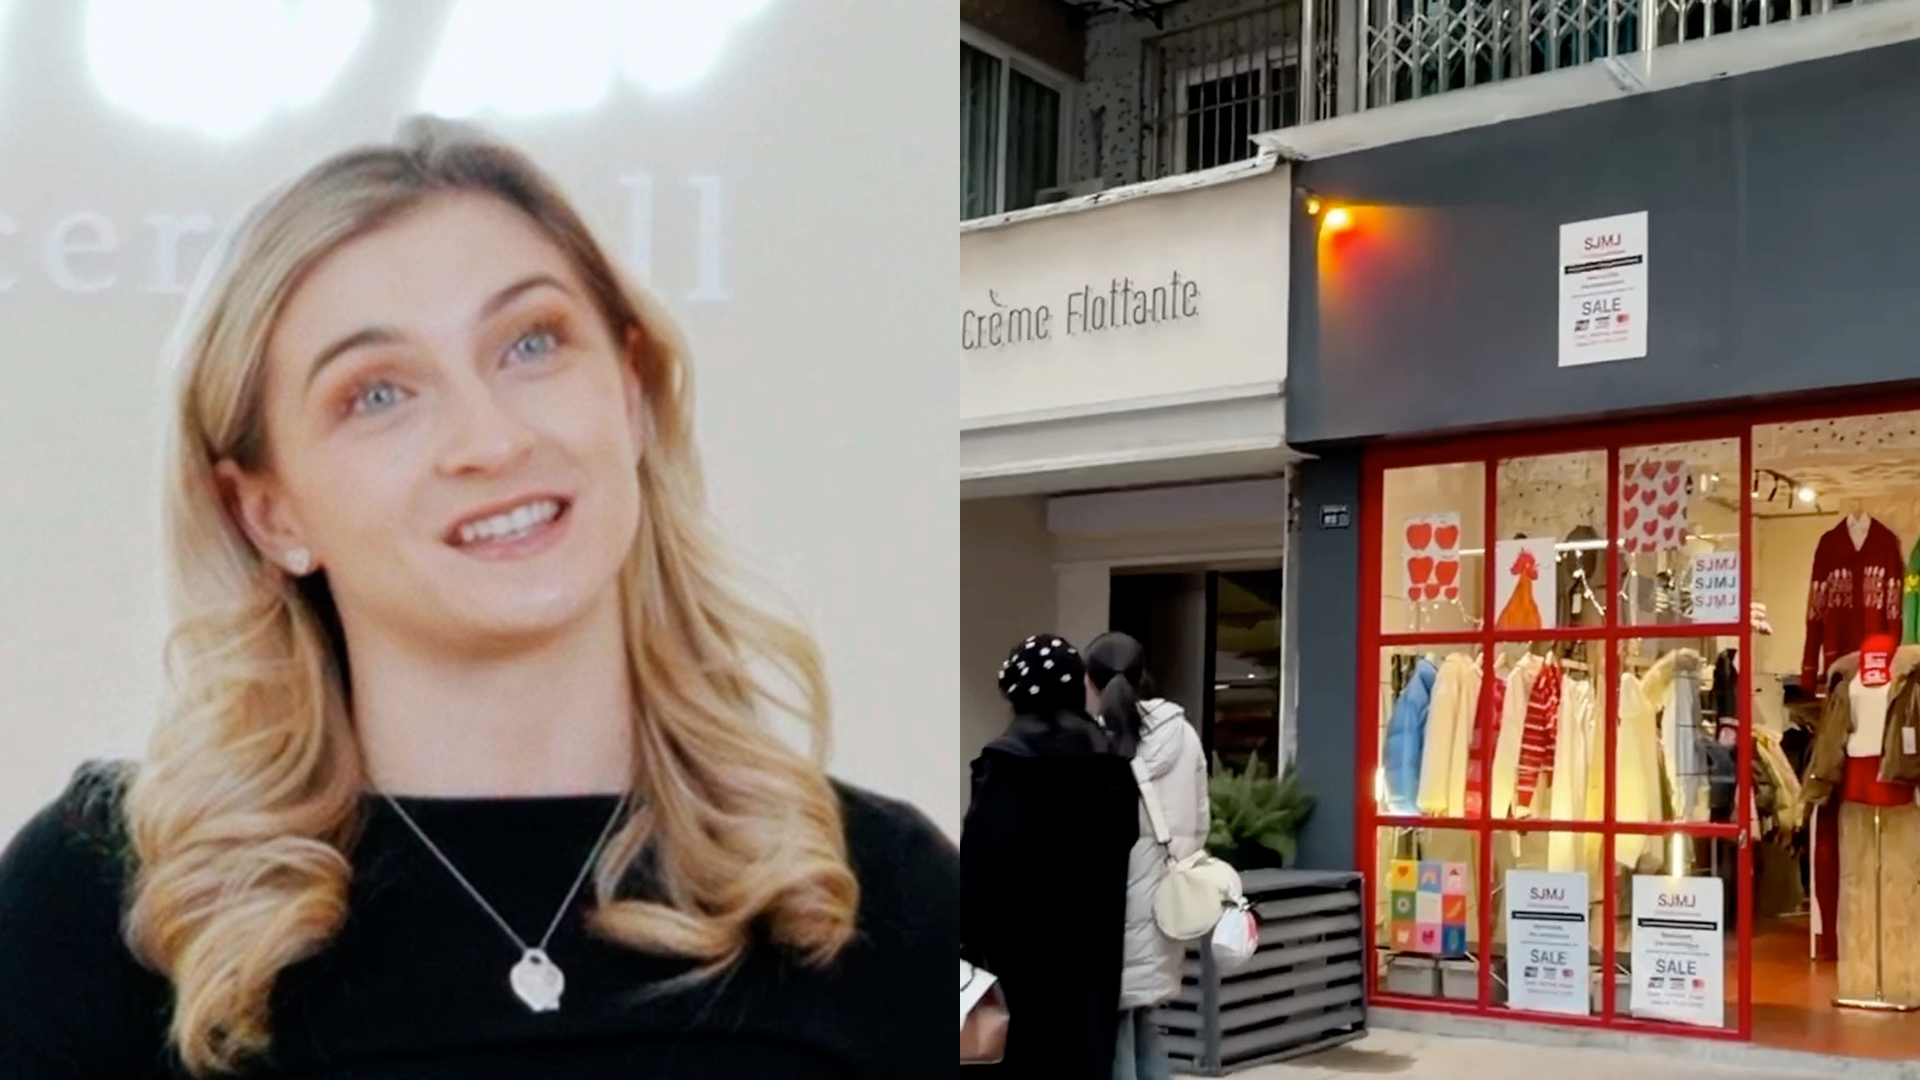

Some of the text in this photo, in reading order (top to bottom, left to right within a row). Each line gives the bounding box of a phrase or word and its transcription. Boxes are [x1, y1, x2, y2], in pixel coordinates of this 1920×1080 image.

[1584, 233, 1622, 251] SJMJ
[961, 270, 1199, 350] Crème Flottante
[1581, 297, 1622, 316] SALE
[1695, 556, 1737, 572] SJMJ
[1694, 575, 1736, 589] SJMJ
[1694, 593, 1736, 607] SJMJ
[1529, 886, 1565, 901] SJMJ
[1657, 893, 1697, 909] SJMJ
[1529, 948, 1568, 966] SALE
[1655, 958, 1698, 976] SALE
